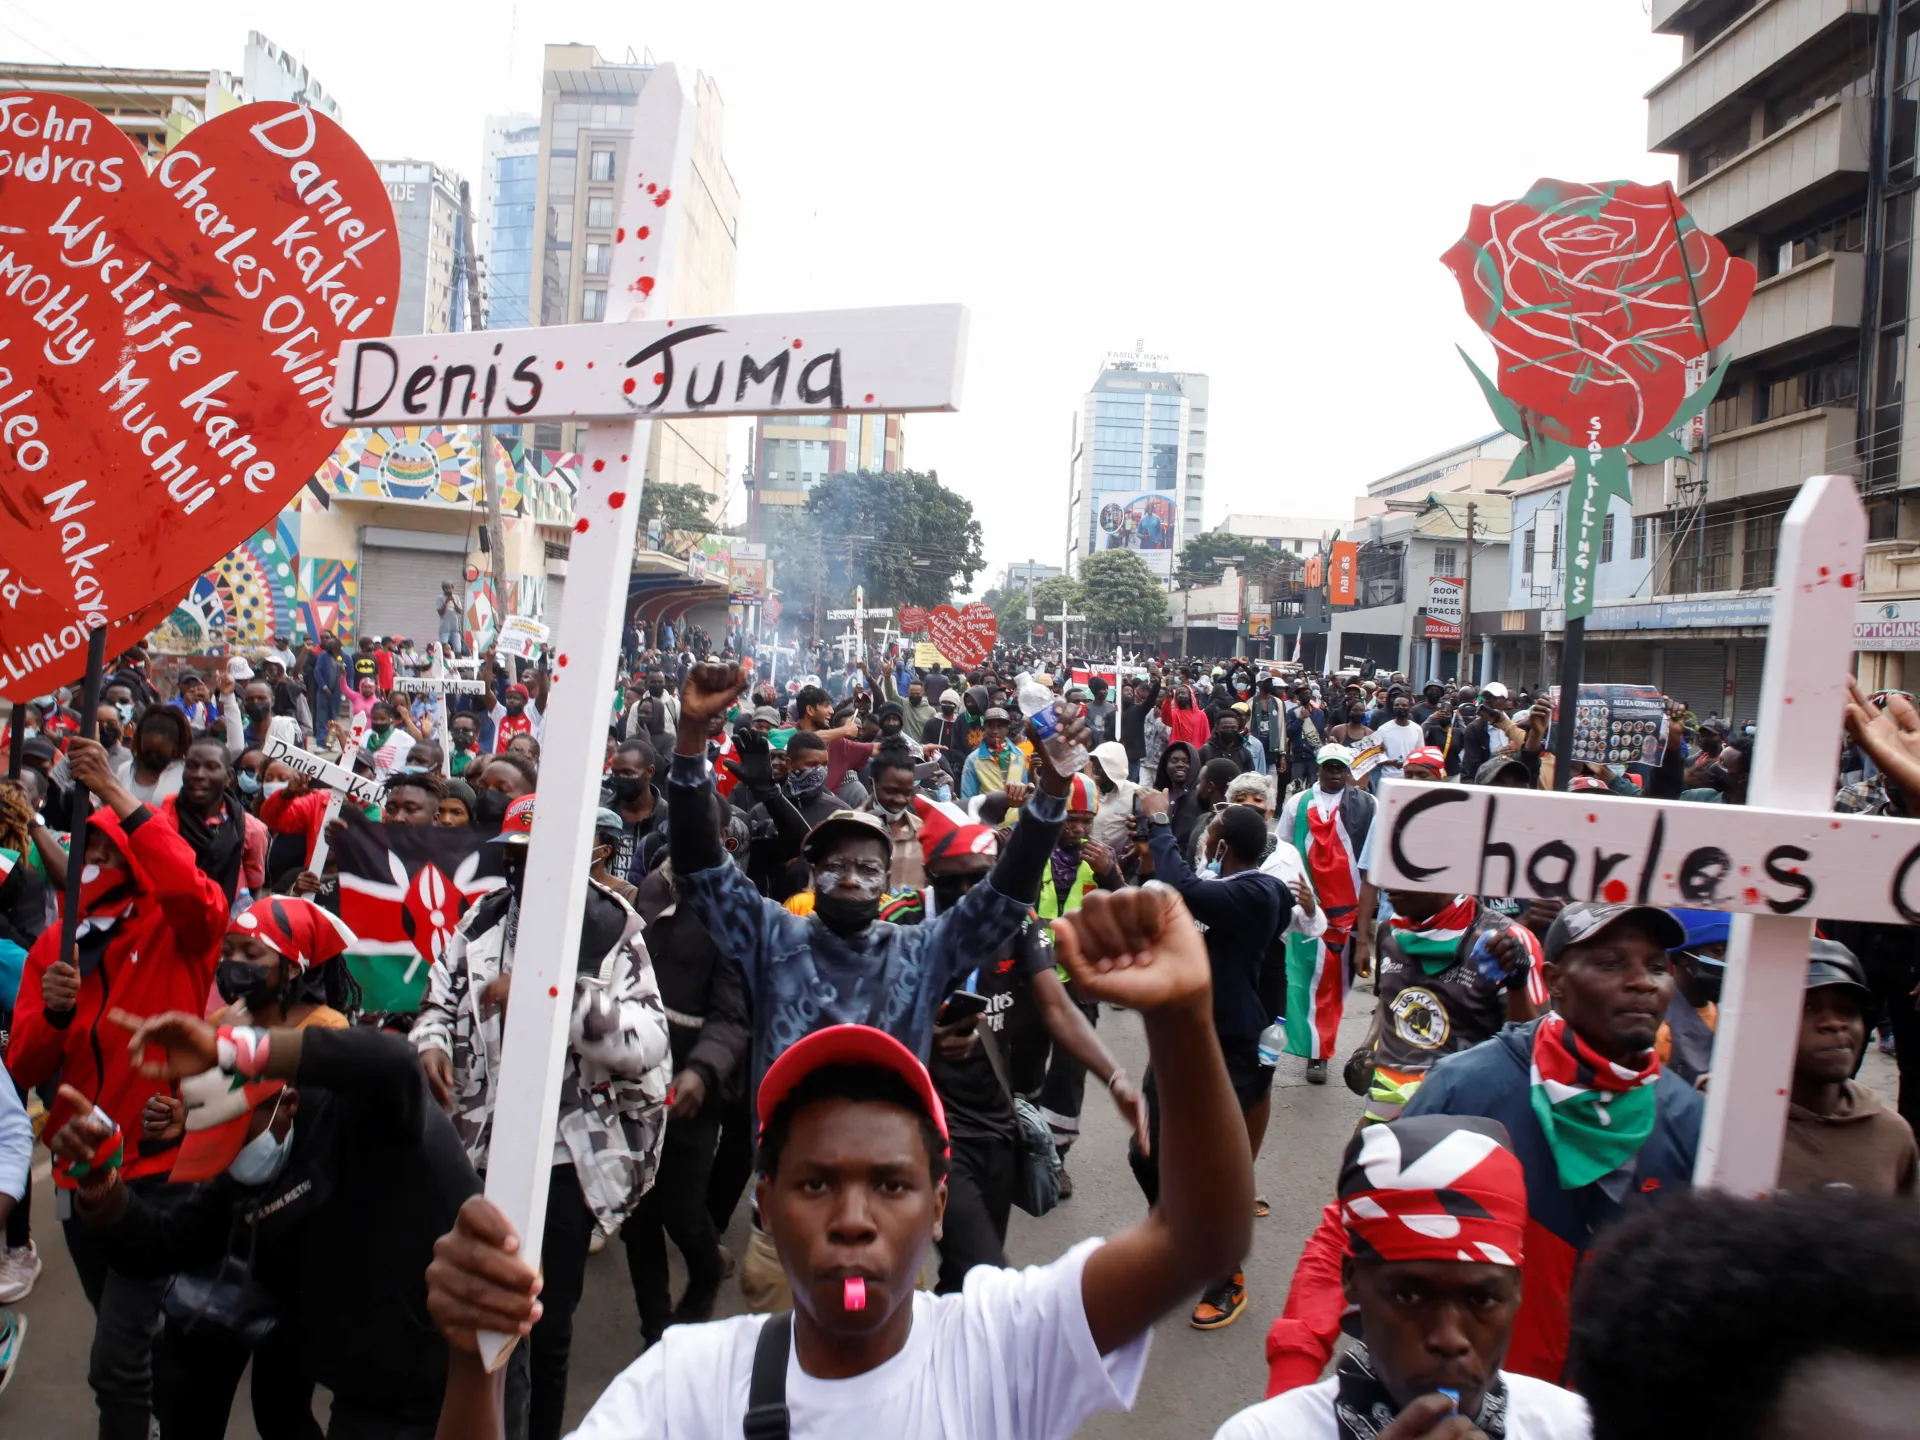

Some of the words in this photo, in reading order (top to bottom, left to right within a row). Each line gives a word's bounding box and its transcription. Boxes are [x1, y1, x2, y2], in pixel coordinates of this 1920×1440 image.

[1107, 351, 1140, 359] FAMILY
[343, 341, 542, 421] Denis
[1586, 416, 1603, 466] STOP
[1574, 473, 1600, 569] KILLING
[1340, 556, 1350, 593] naivas
[1431, 597, 1460, 605] THESE
[1433, 587, 1459, 595] BOOK
[1427, 607, 1461, 615] SPACES
[1854, 622, 1920, 637] OPTICIANS
[396, 680, 435, 693] Timothy
[269, 740, 327, 779] Daniel
[1390, 788, 1816, 914] Charles
